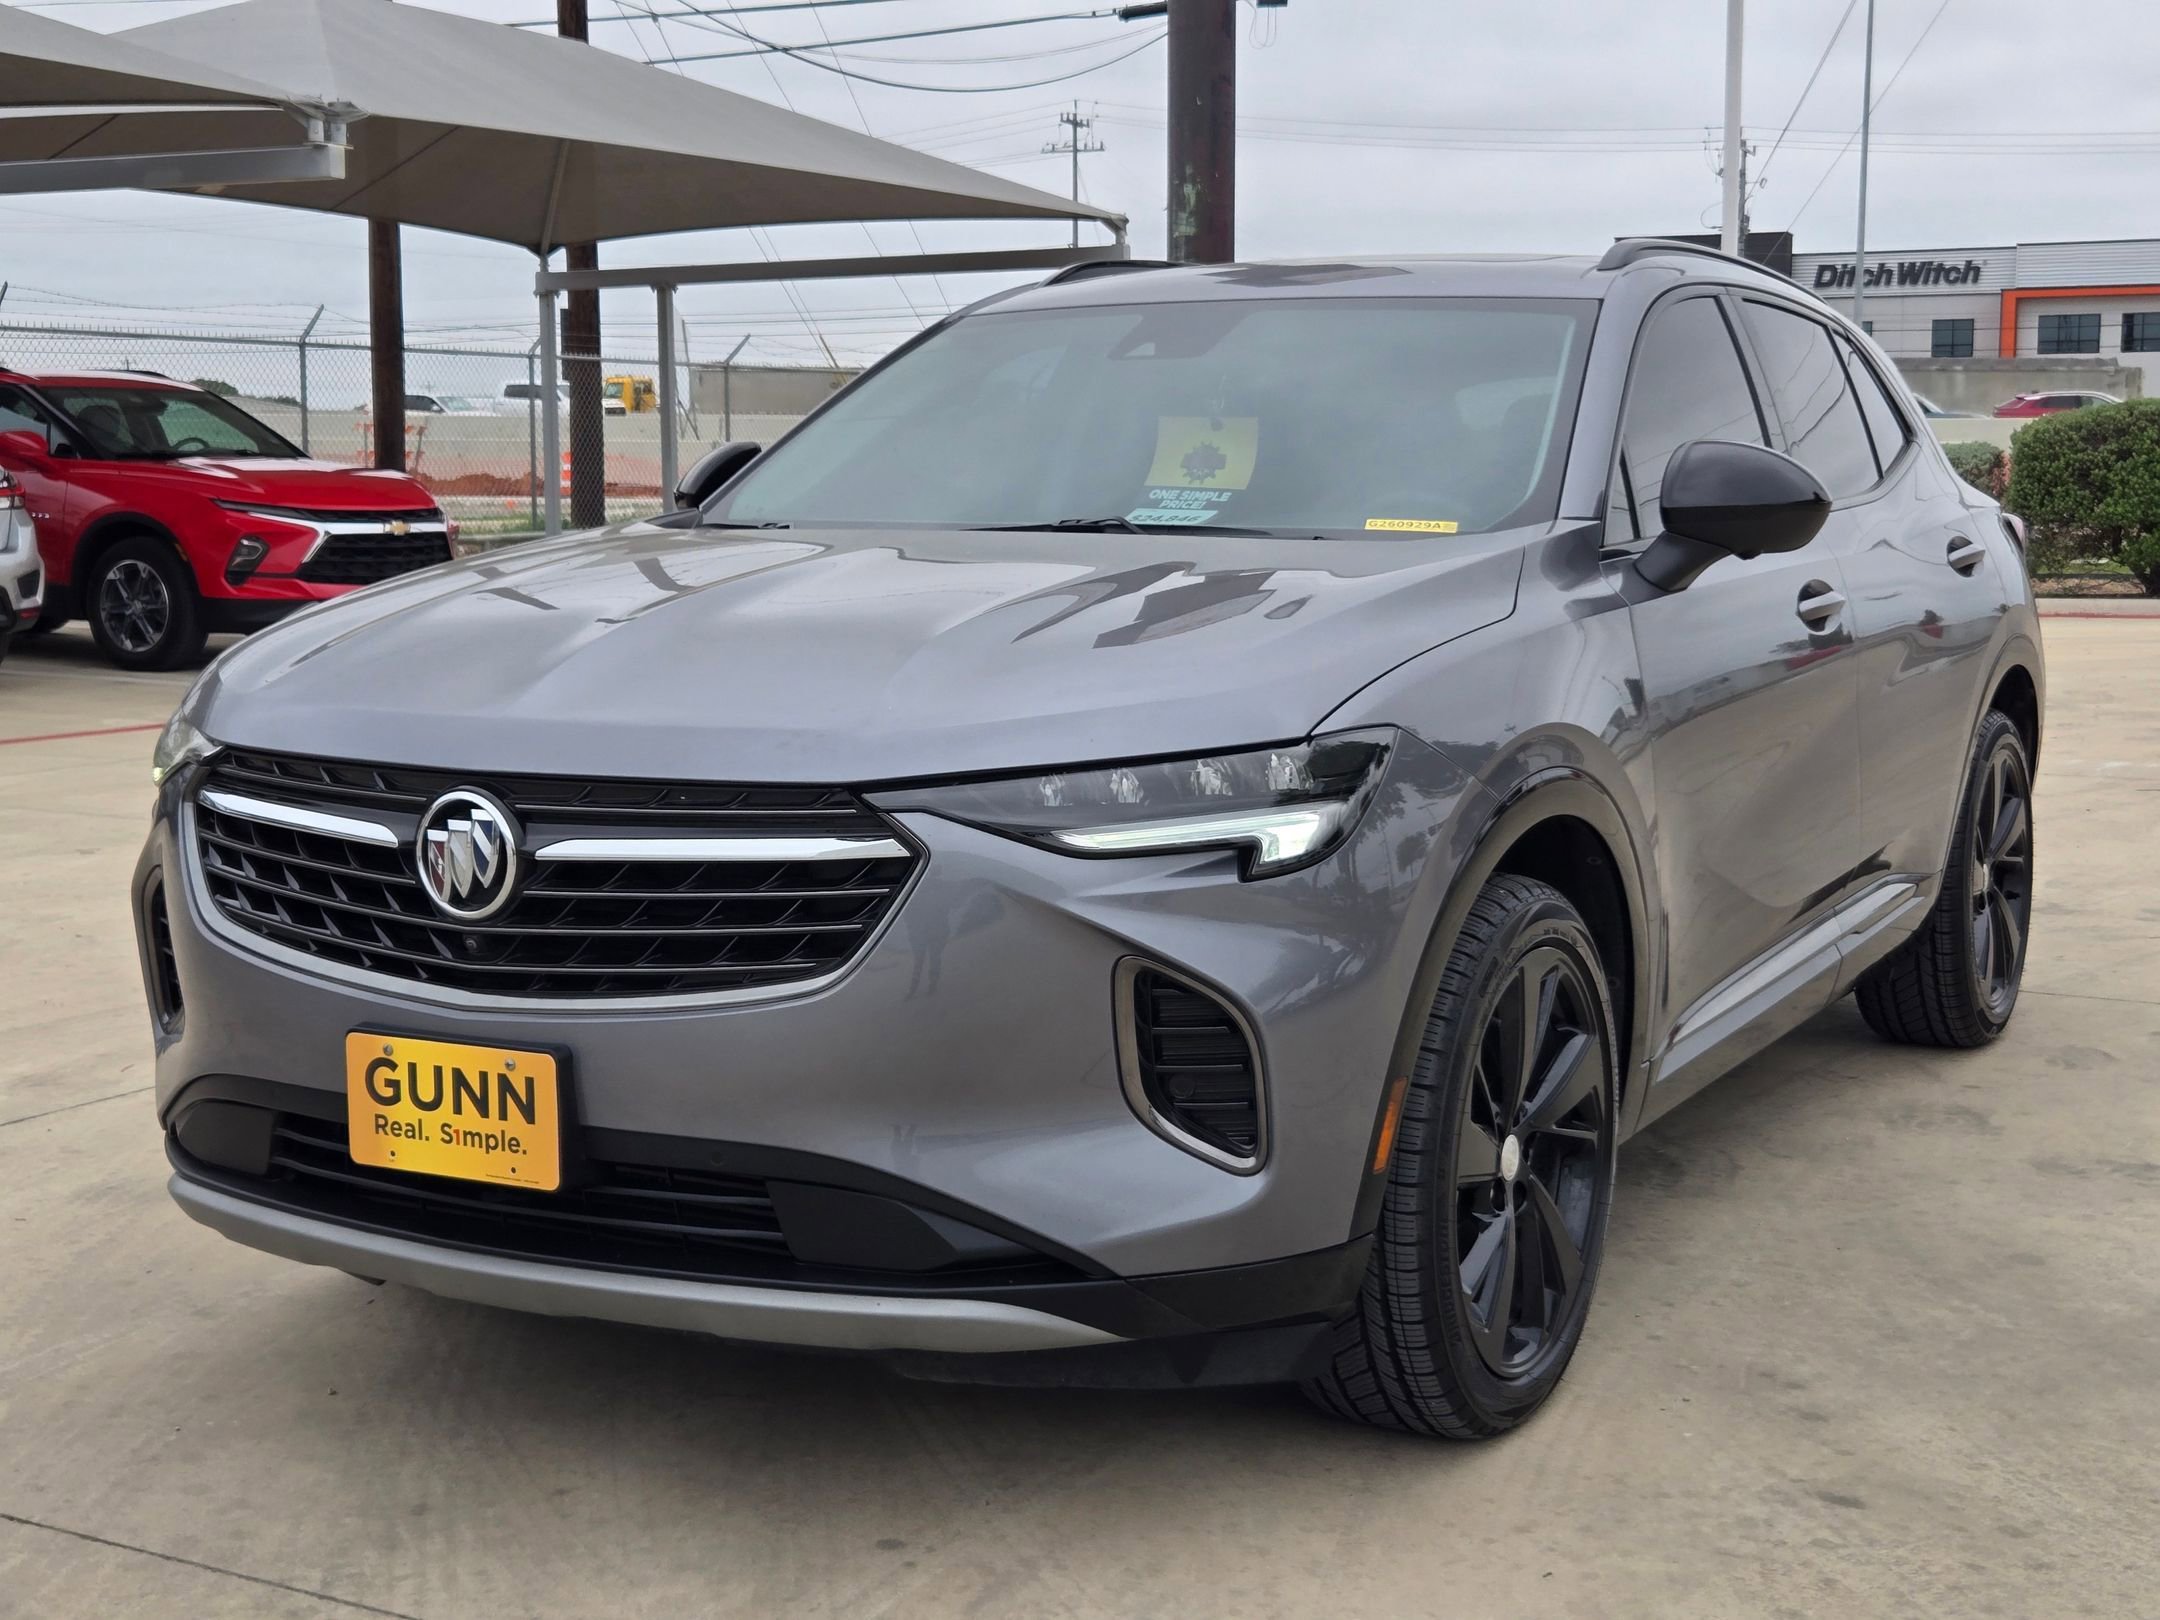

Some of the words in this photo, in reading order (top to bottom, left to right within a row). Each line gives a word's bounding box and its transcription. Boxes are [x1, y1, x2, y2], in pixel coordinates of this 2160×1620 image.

[1814, 263, 1893, 288] Ditch
[1898, 260, 1981, 286] Witch
[1148, 489, 1179, 500] ONE
[1180, 490, 1233, 502] SIMPLE
[1158, 500, 1207, 509] PRICE!
[1368, 520, 1442, 530] G260929A
[365, 1057, 536, 1125] GUNN
[374, 1113, 430, 1141] Real.
